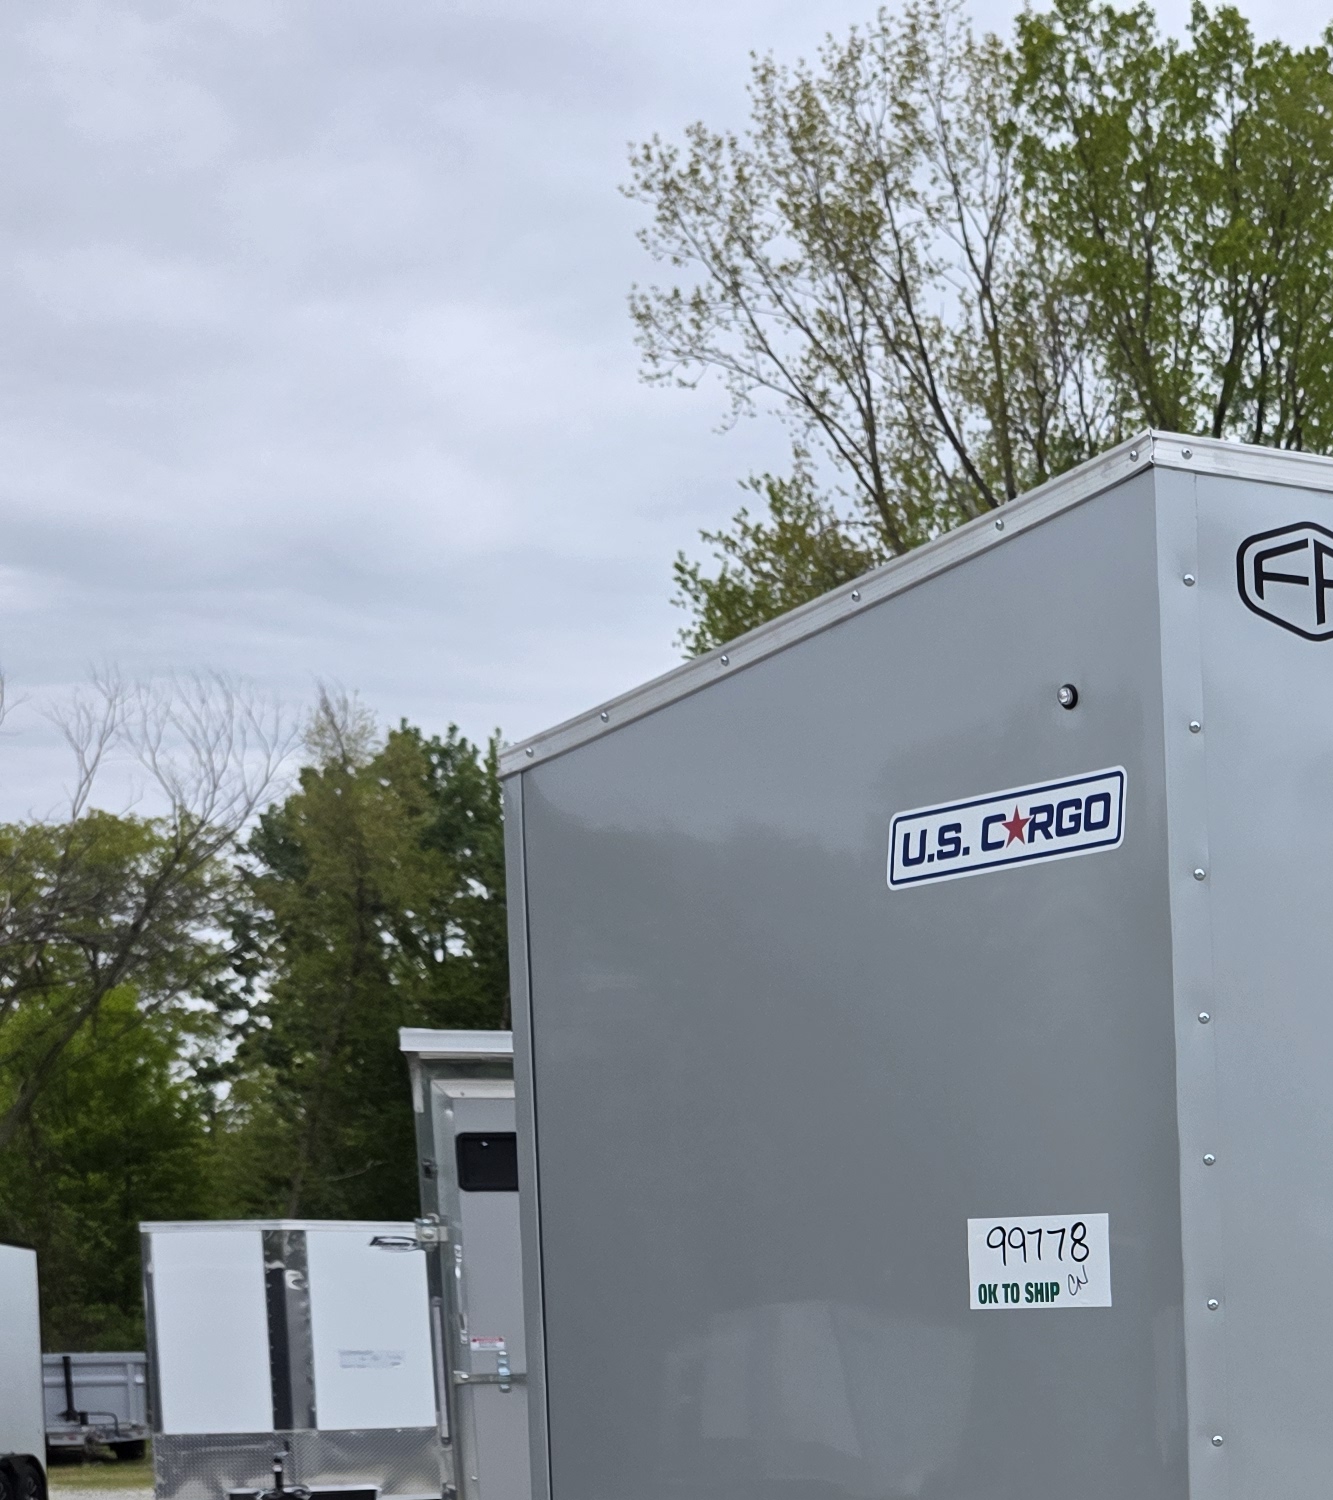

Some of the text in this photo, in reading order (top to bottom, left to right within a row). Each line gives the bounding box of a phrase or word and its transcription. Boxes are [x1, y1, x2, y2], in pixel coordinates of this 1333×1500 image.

[902, 822, 971, 868] U.S.
[986, 1221, 1090, 1267] 99778
[977, 1281, 1060, 1305] OK TO SHIP
